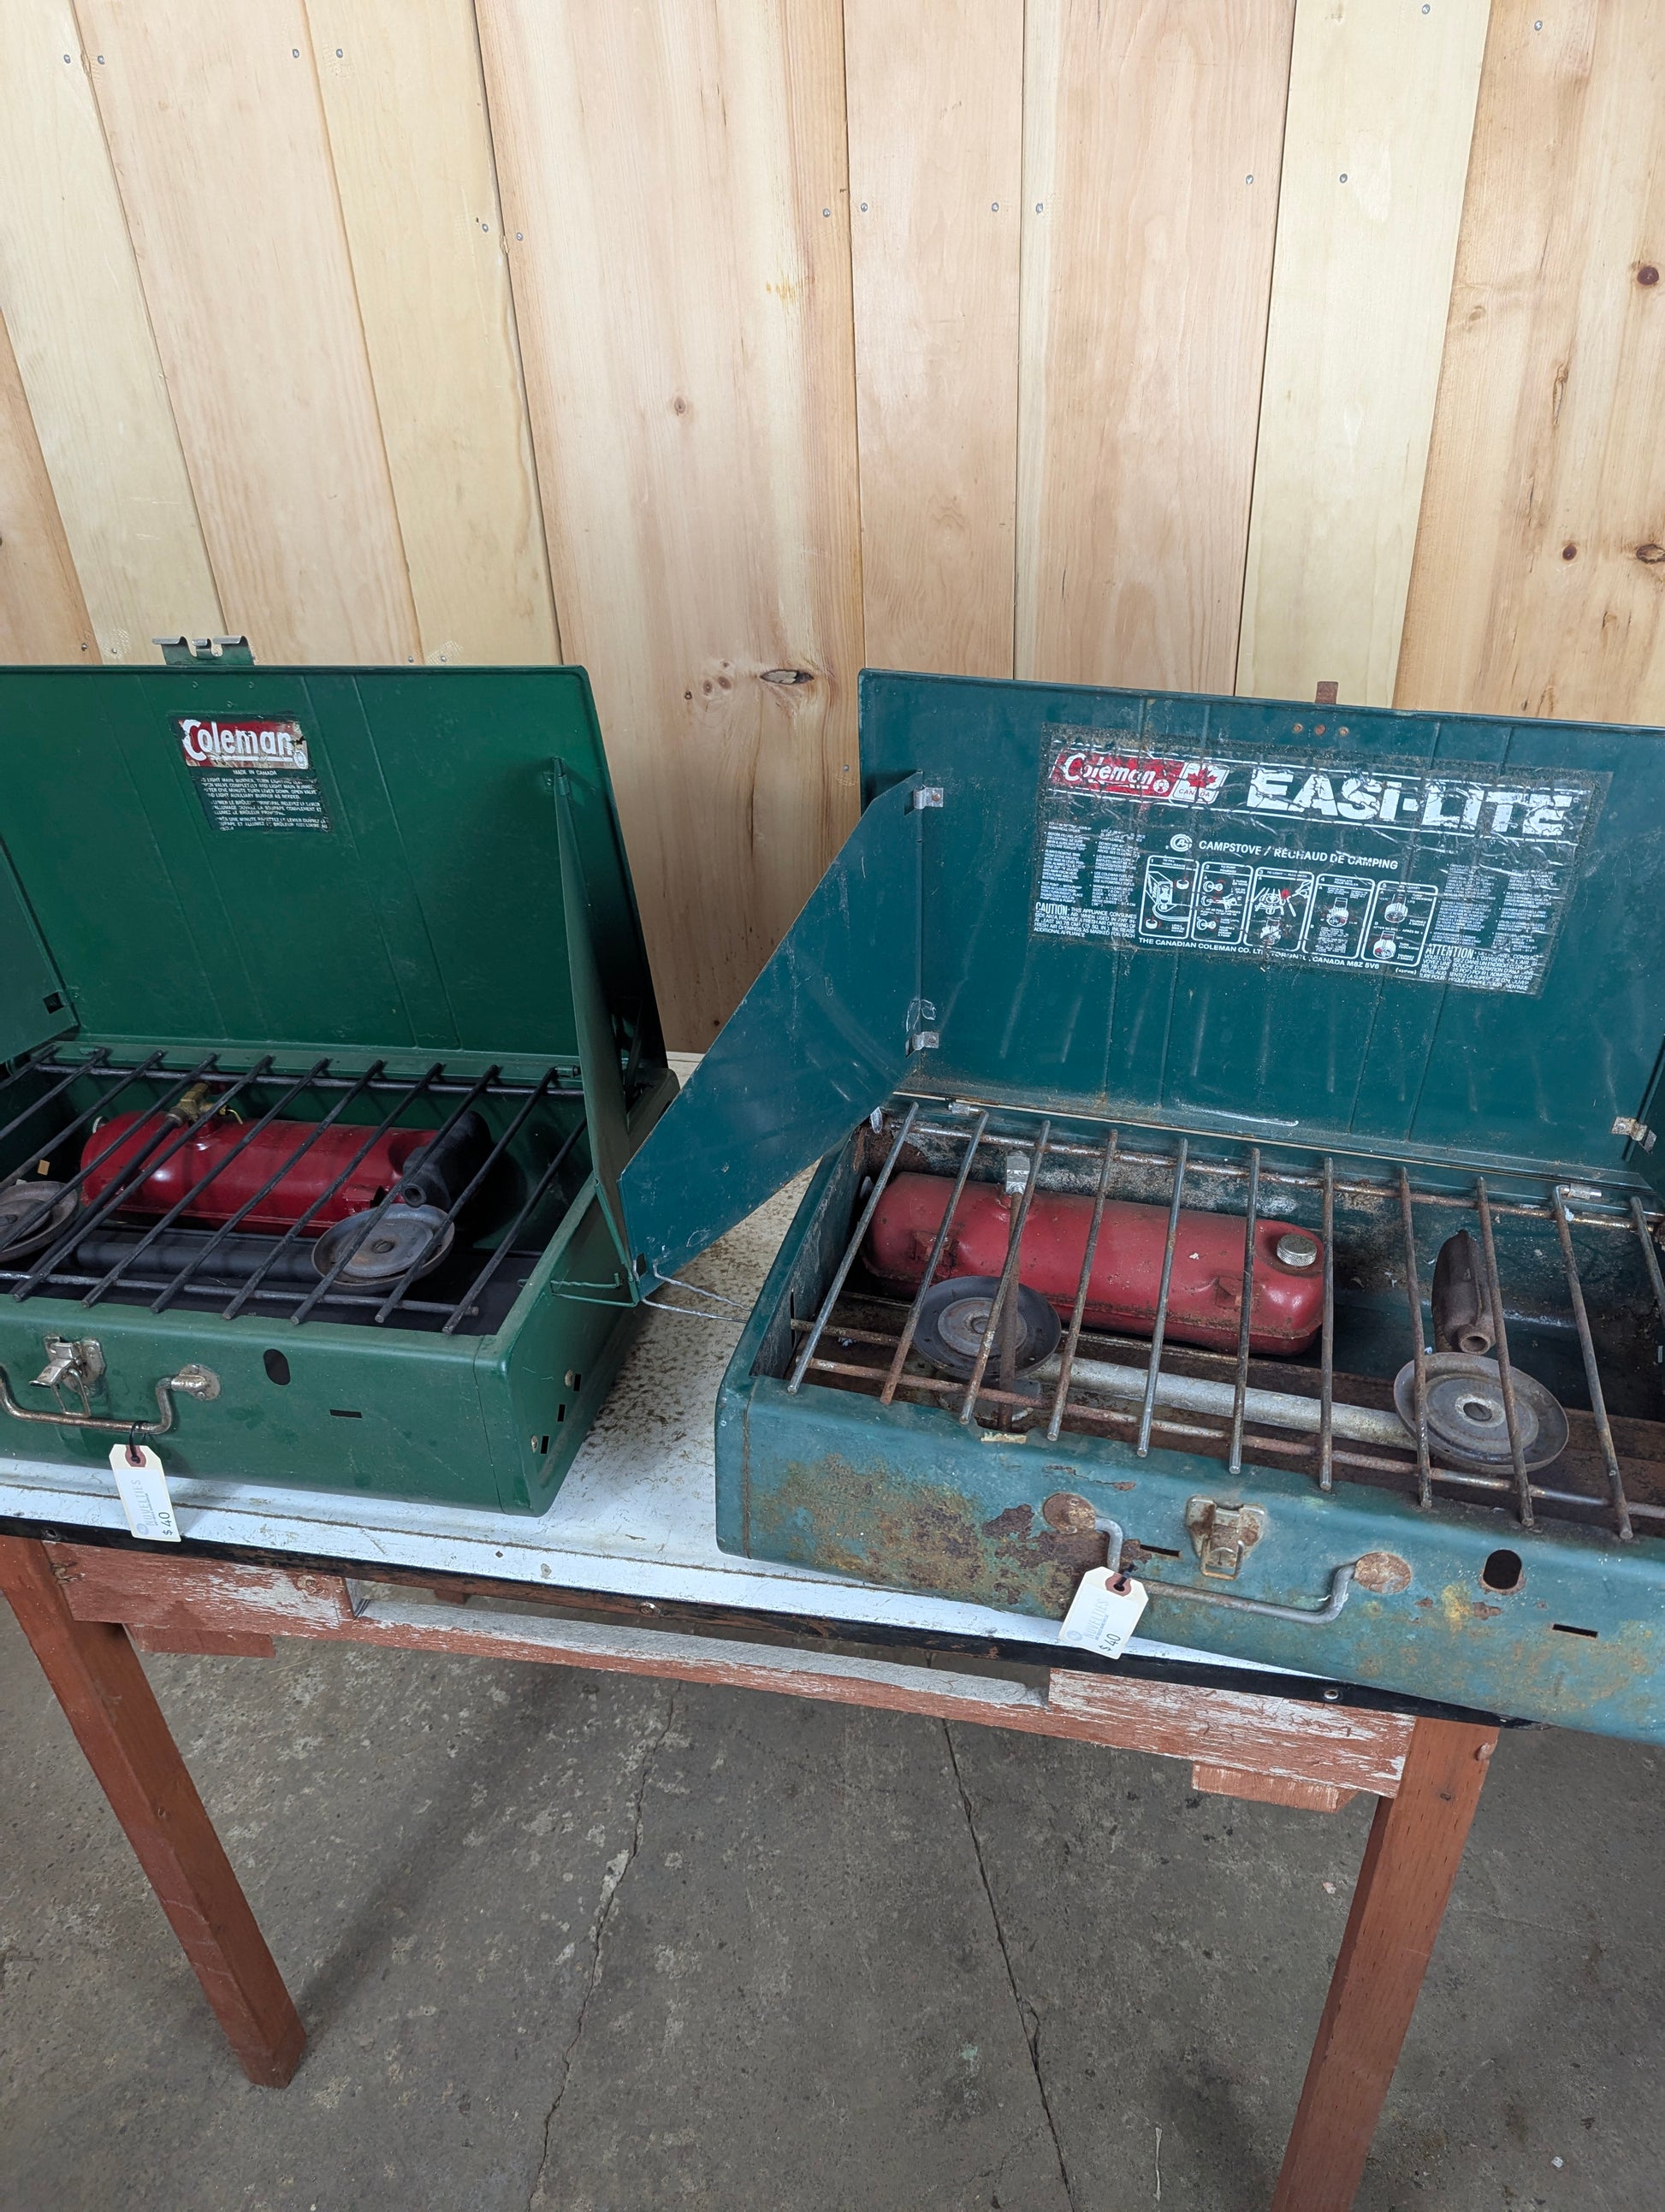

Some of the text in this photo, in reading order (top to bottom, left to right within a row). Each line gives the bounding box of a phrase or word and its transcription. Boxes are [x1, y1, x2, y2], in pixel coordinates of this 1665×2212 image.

[182, 720, 293, 761] Coleman
[1063, 752, 1156, 785] Coleman
[1178, 788, 1211, 798] CANDA
[1247, 768, 1573, 836] EASI-LITE
[1199, 840, 1262, 855] CAMPSTOVE
[1330, 853, 1344, 863] DE
[1348, 857, 1398, 869] CAMPING
[1034, 901, 1070, 916] CAUTION:
[1155, 940, 1196, 948] CANADIAN
[1198, 943, 1236, 952] COLEMAN
[1312, 957, 1345, 966] CANADA
[1425, 943, 1477, 959] ATTENTION:
[158, 1511, 171, 1527] 40
[1104, 1633, 1122, 1646] 40
